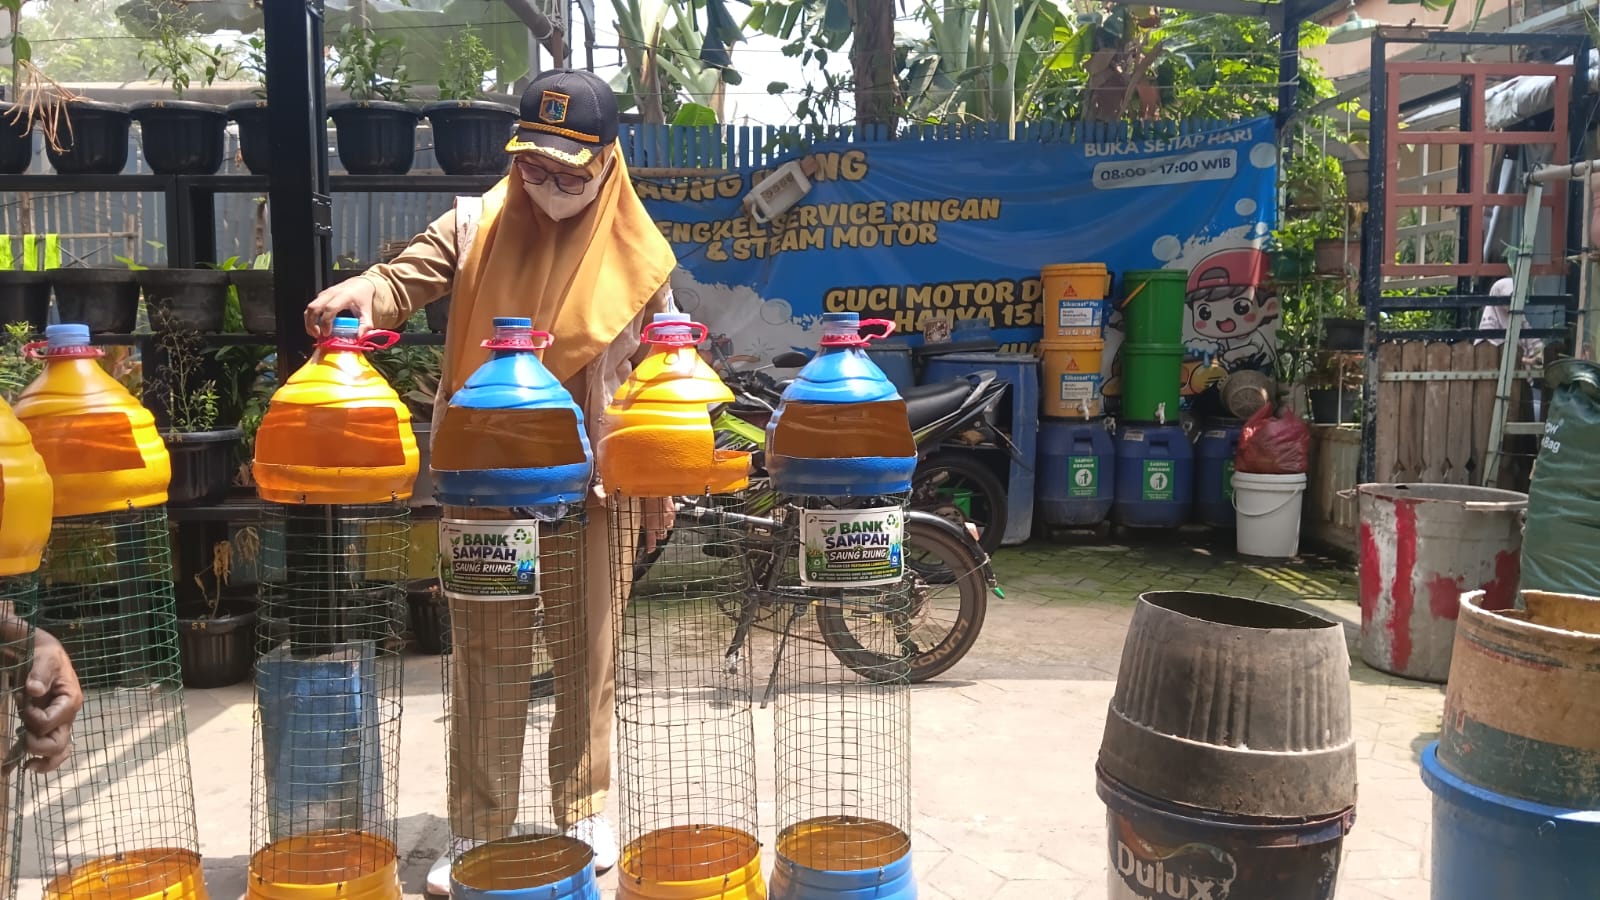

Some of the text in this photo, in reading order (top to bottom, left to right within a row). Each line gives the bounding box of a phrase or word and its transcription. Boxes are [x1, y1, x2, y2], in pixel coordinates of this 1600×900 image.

[1085, 128, 1252, 157] BUKA SETIAP HARI
[1101, 167, 1146, 181] 08:00
[1160, 160, 1199, 174] 17:00
[1201, 157, 1231, 171] WIB
[893, 198, 1000, 222] RINGAN
[706, 223, 938, 261] & STEAM MOTOR
[826, 288, 897, 312] CUCI
[906, 280, 1014, 309] MOTOR
[840, 521, 884, 534] BANK
[463, 533, 509, 547] BANK
[825, 533, 890, 550] SAMPAH
[452, 546, 517, 561] SAMPAH
[829, 549, 886, 561] SAUNG RIUNG
[455, 562, 512, 574] SAUNG RIUNG
[1117, 840, 1214, 900] Dulux
